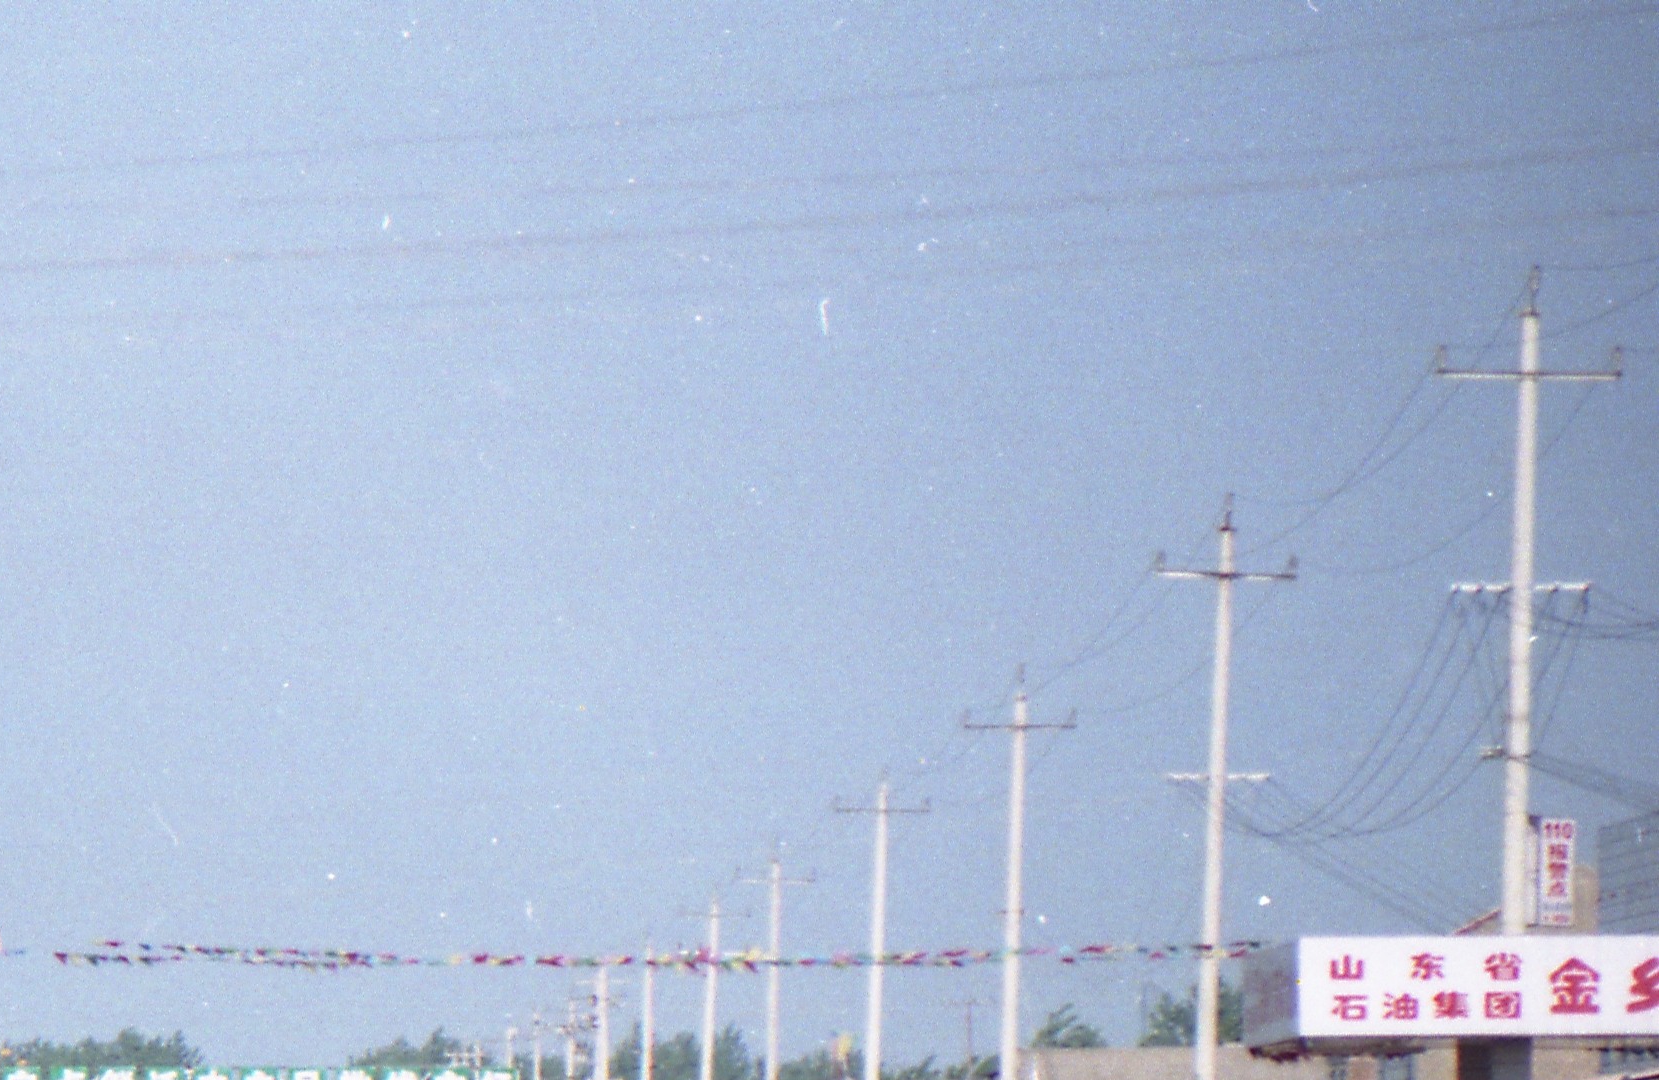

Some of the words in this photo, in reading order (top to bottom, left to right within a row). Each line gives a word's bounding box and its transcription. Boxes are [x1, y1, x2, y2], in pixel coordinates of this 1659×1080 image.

[1329, 953, 1522, 981] 山东省
[1331, 991, 1522, 1020] 石油集团
